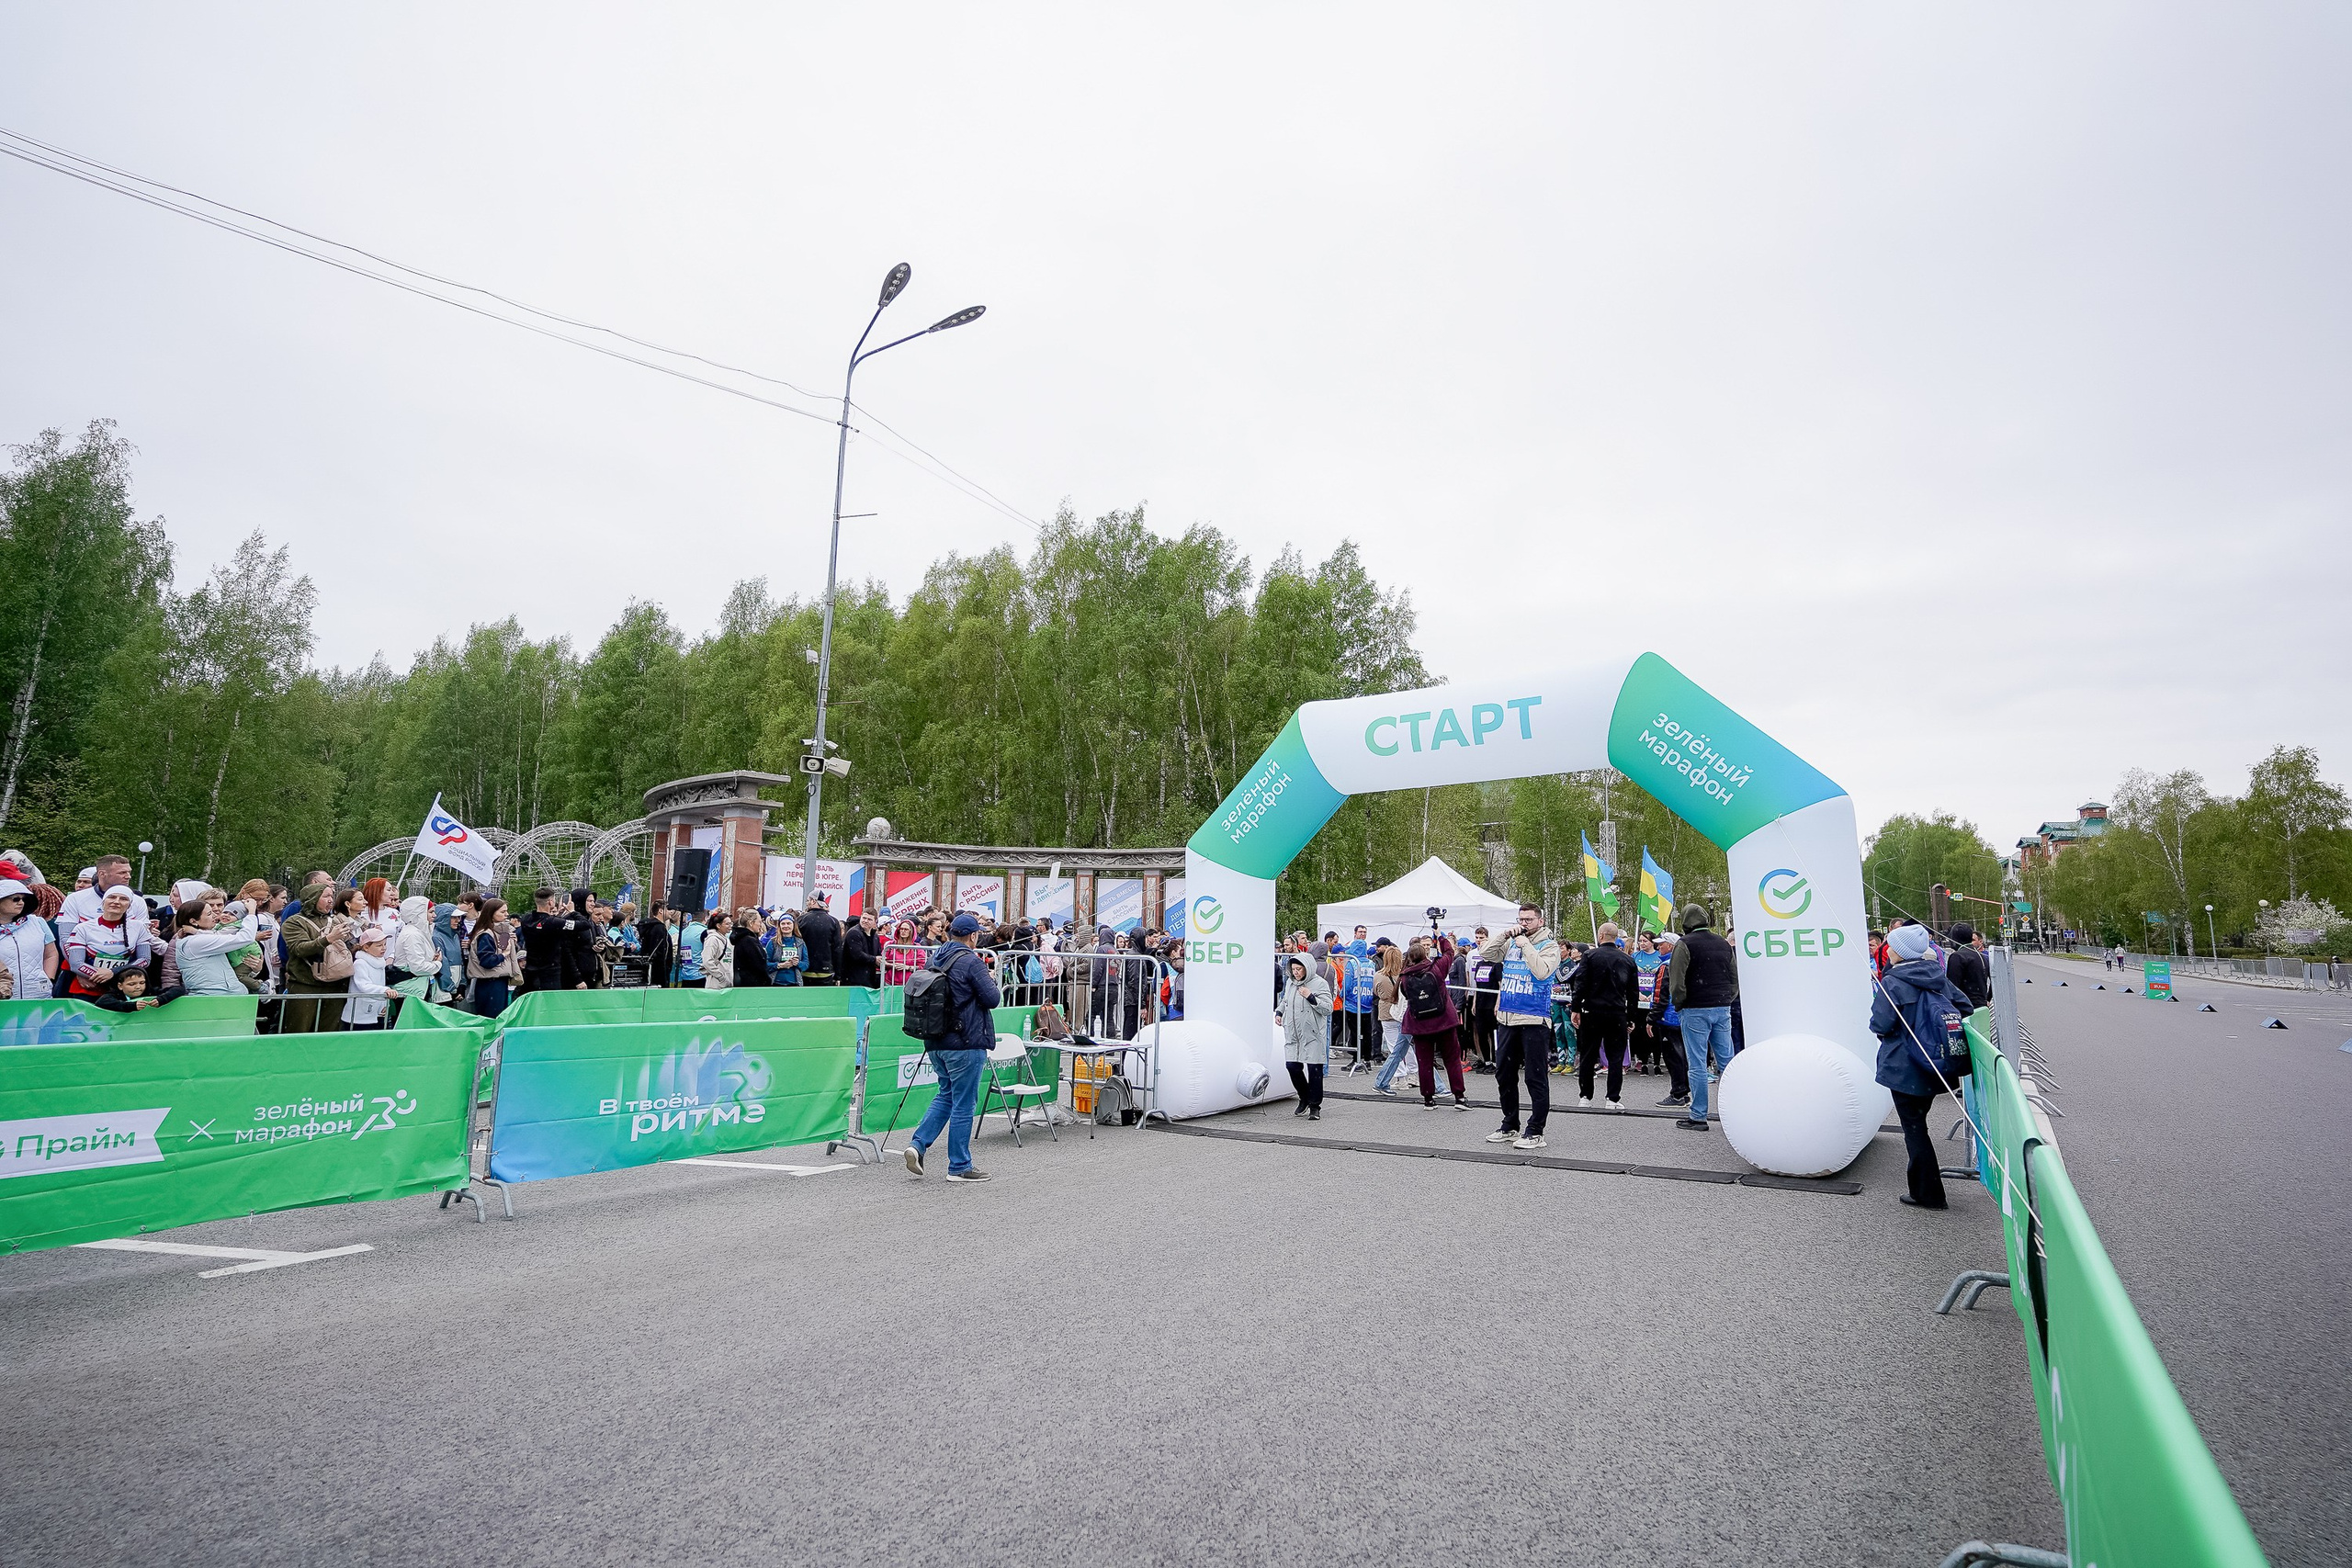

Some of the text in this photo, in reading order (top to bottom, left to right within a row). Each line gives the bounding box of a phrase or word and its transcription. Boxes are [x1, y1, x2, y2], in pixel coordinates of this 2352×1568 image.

[1364, 695, 1543, 756] СТАРТ
[1652, 712, 1755, 788] зелёный
[1637, 728, 1735, 807] марафон
[1220, 758, 1282, 832] зелёный
[1229, 772, 1293, 845] марафон
[449, 845, 486, 867] СОЦИАЛЬНЫЙ
[795, 863, 835, 872] ФЕВАЛЬ
[890, 886, 929, 912] ДВИЖЕНИЕ
[961, 884, 982, 897] БЫТЬ
[966, 883, 1001, 905] РОССИЕЙ
[1034, 884, 1049, 897] БЫТ
[1100, 882, 1139, 908] БЫТЬ ВМЕСТЕ
[1185, 941, 1244, 964] СБЕР
[1743, 928, 1845, 958] СБЕР
[254, 1093, 365, 1122] зелёный
[599, 1092, 699, 1115] В твоём
[234, 1117, 353, 1145] марафон
[630, 1103, 766, 1142] ритме
[15, 1126, 136, 1161] Прайм
